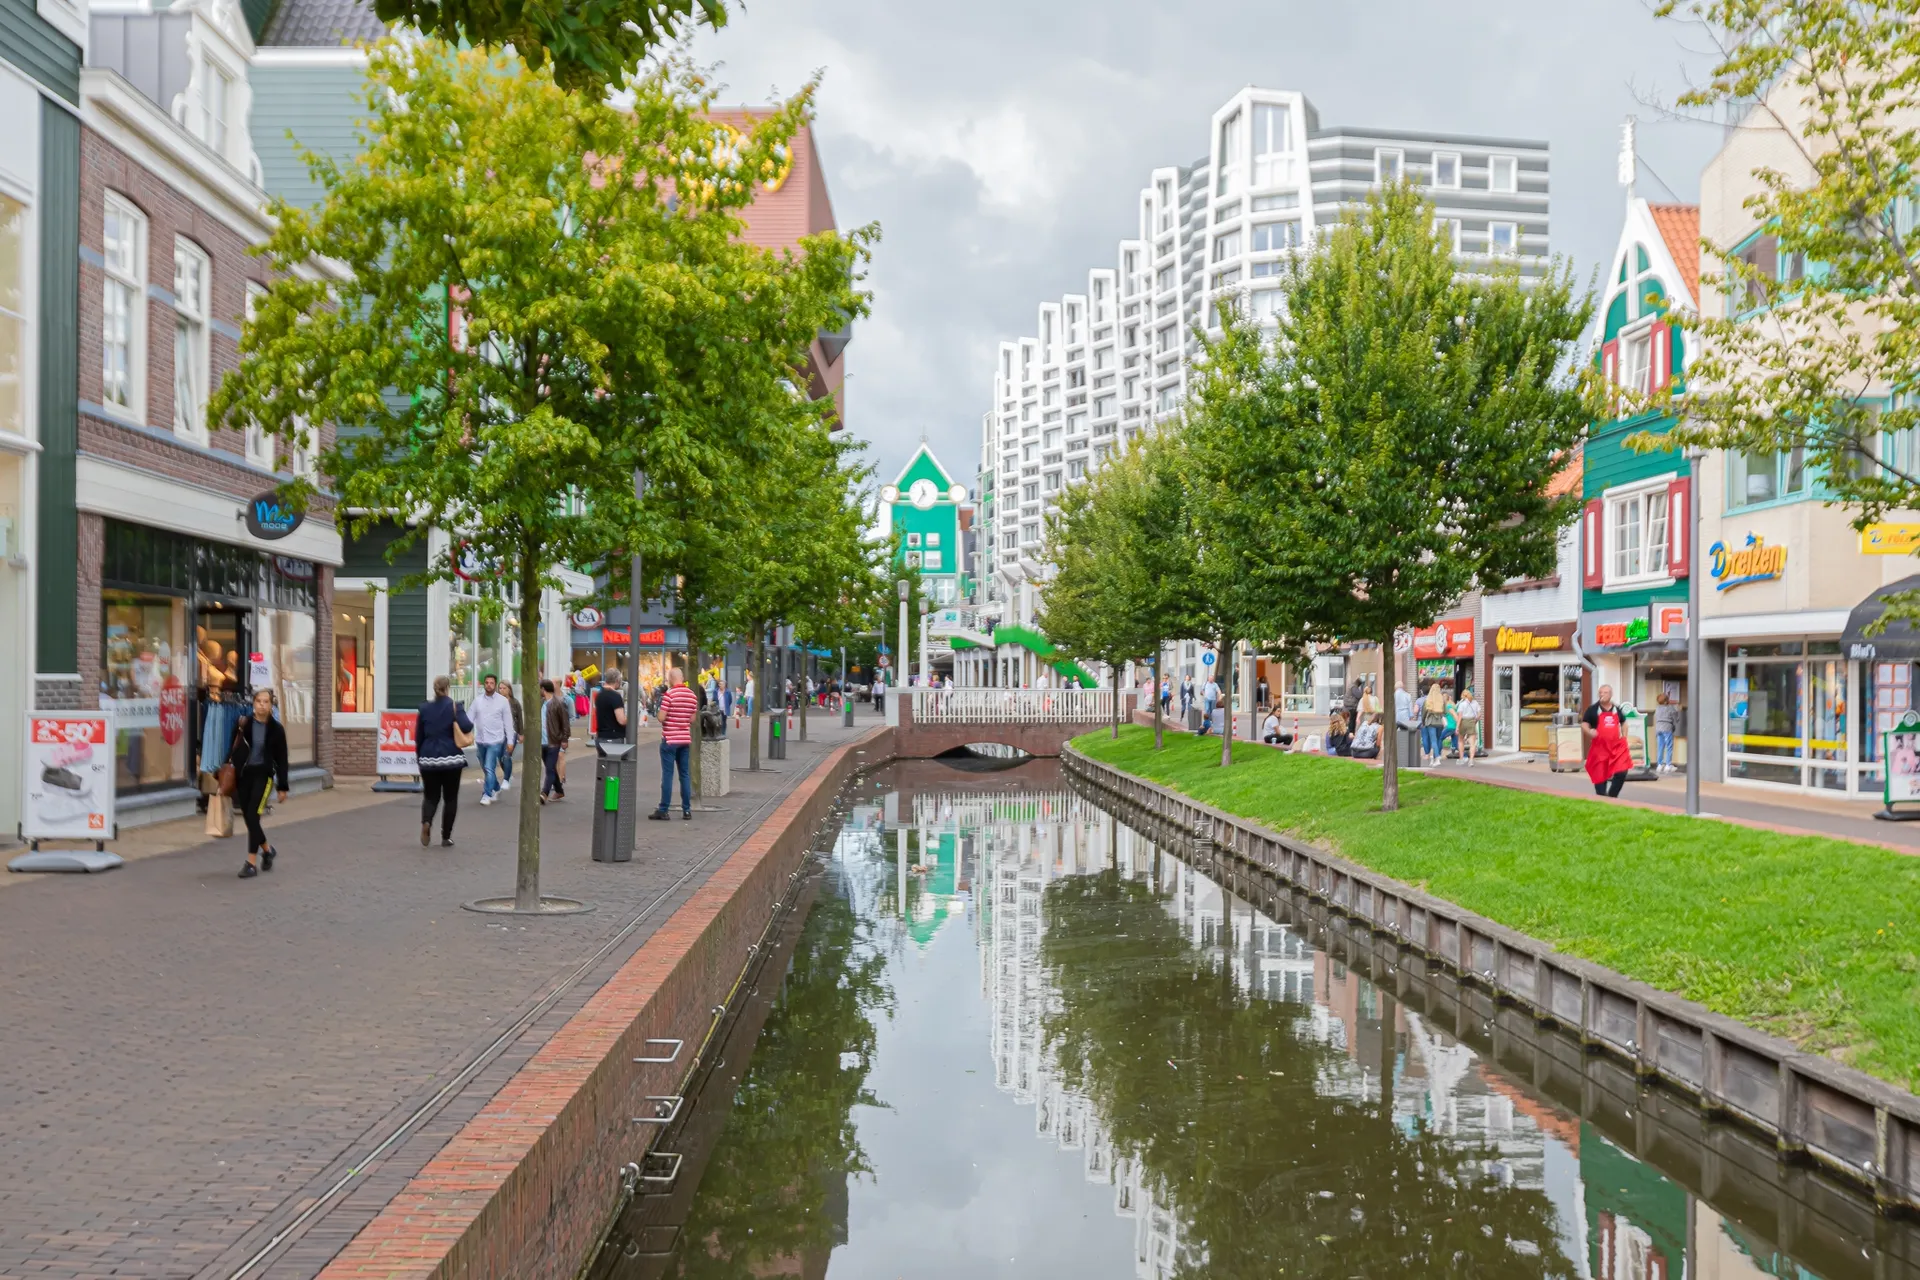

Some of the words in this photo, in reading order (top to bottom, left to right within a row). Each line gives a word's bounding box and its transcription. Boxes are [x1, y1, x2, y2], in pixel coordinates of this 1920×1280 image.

[576, 611, 596, 622] C&A
[162, 688, 183, 705] SALE
[162, 712, 183, 729] -70%
[379, 728, 416, 745] SAL
